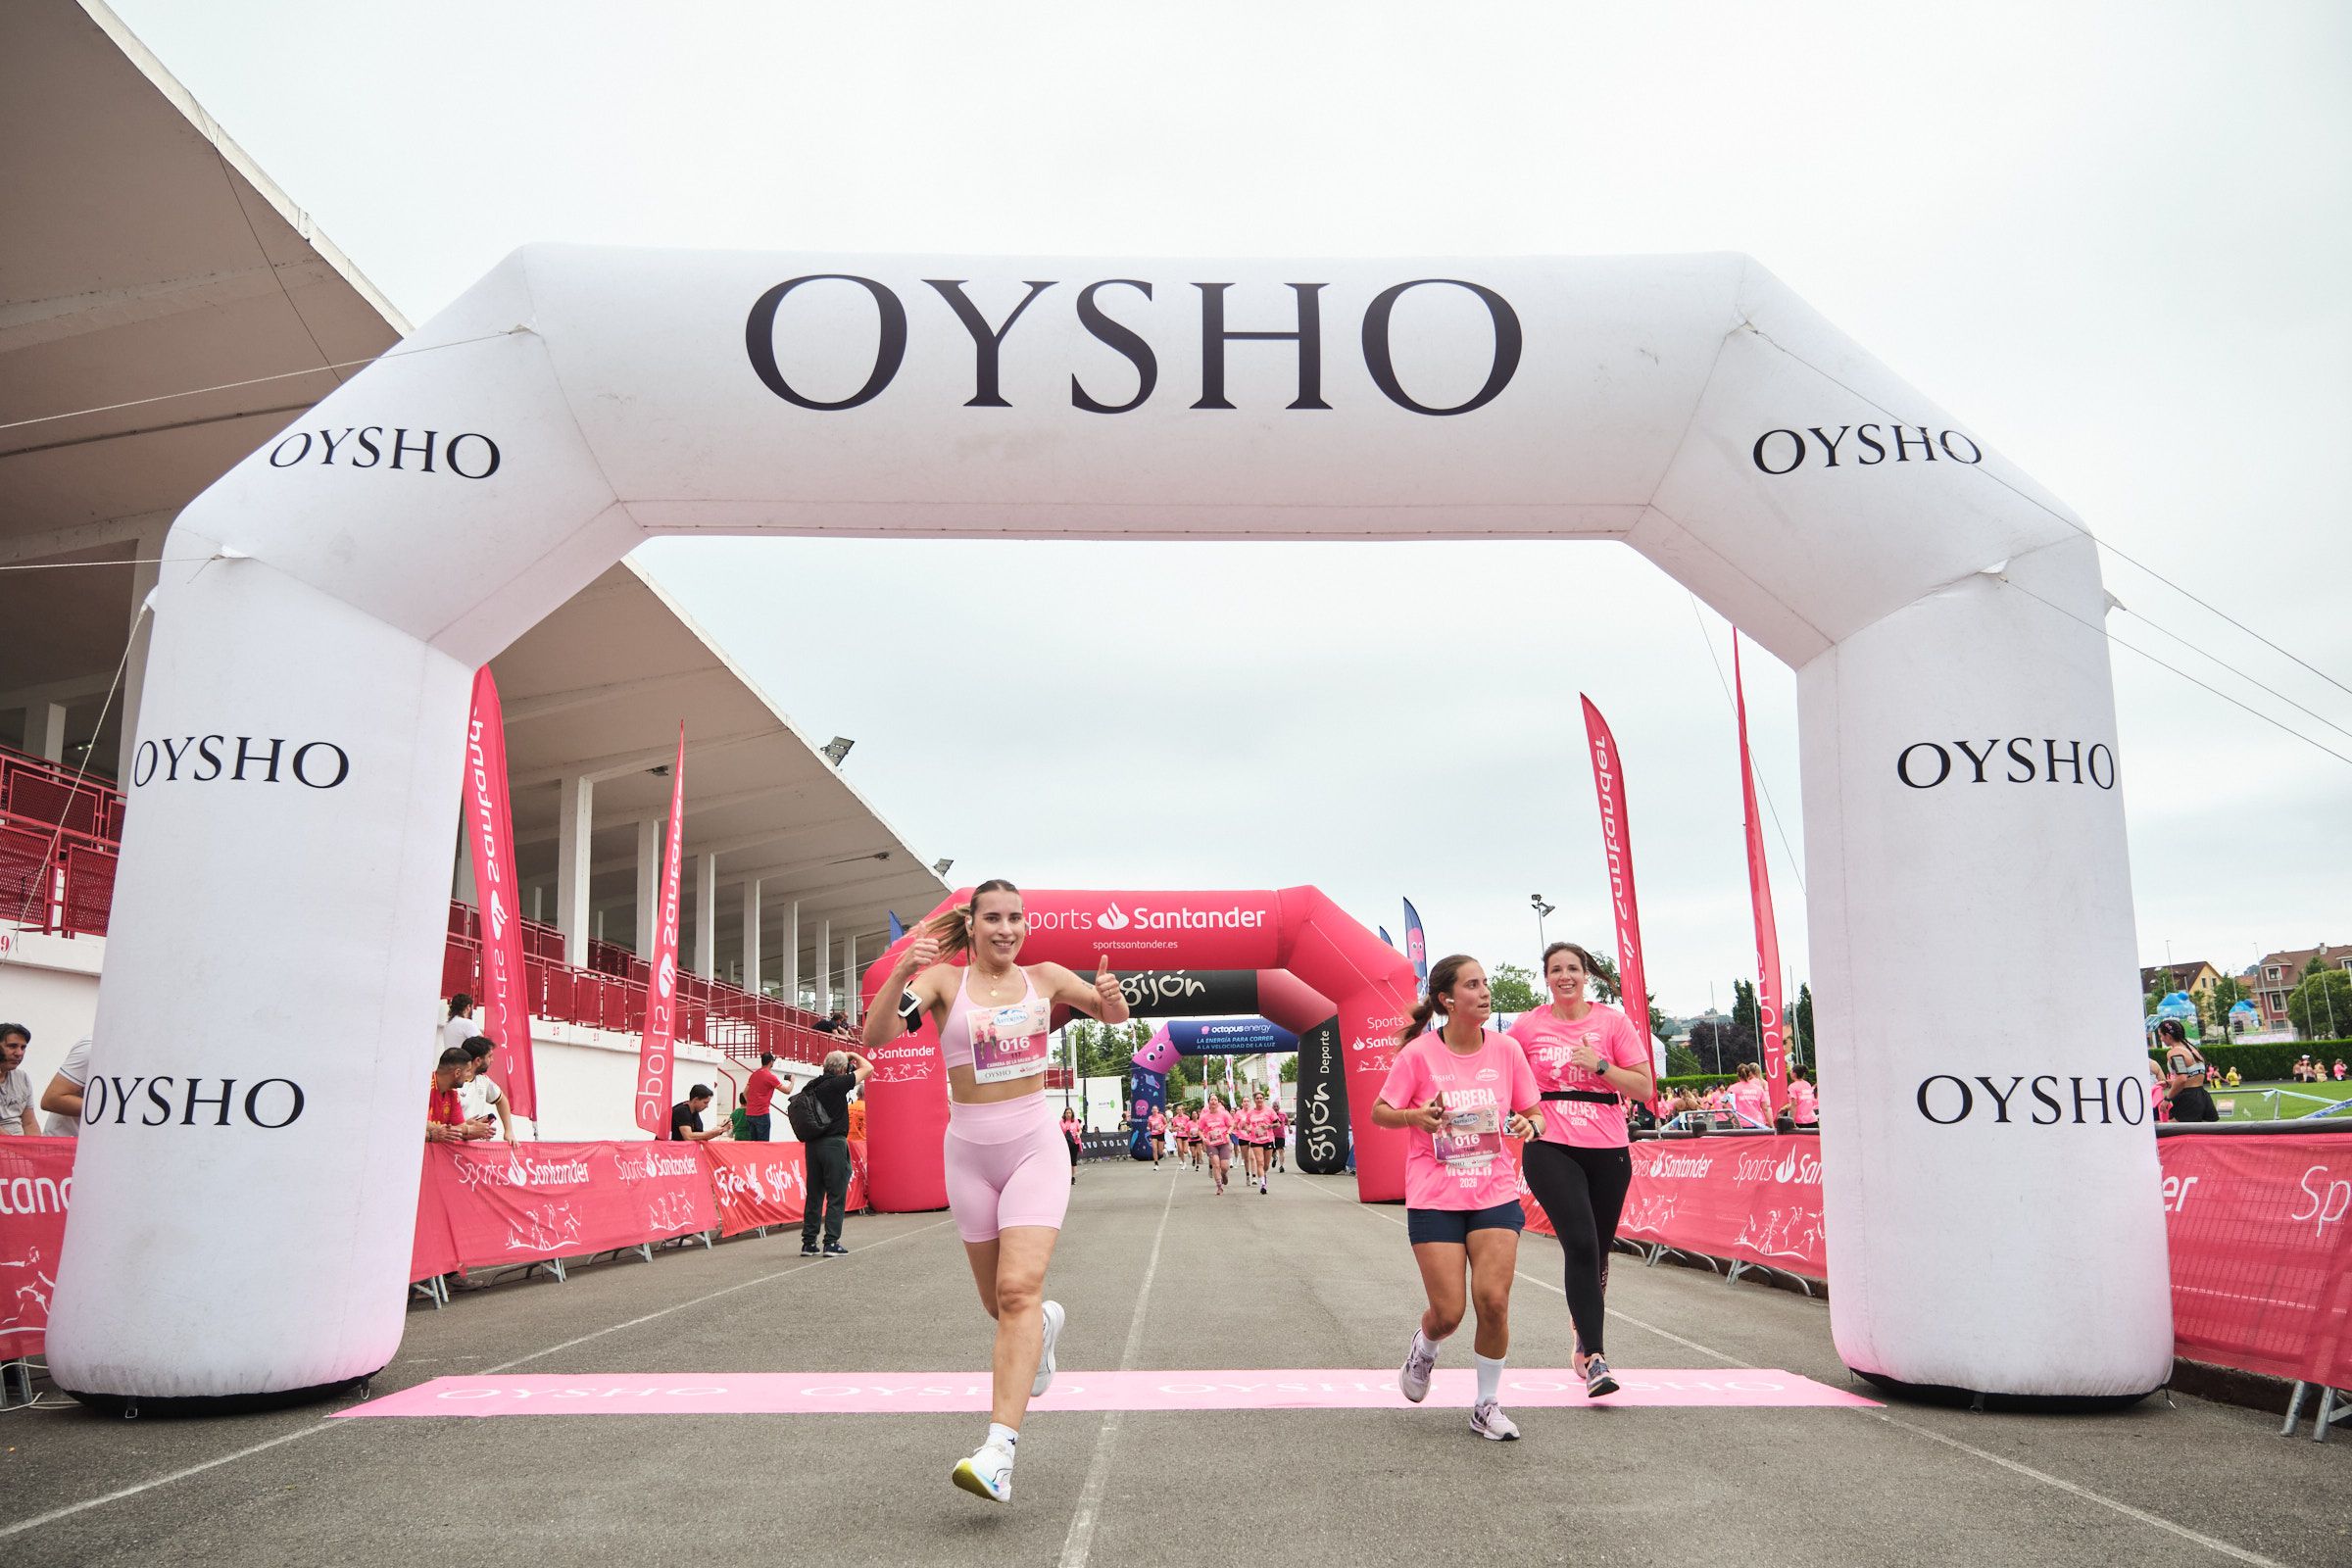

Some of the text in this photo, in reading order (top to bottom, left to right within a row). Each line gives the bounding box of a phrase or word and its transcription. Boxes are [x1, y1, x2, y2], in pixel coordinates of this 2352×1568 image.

[746, 274, 1523, 416] OYSHO
[270, 426, 501, 479] OYSHO
[1753, 423, 1983, 475] OYSHO
[134, 734, 349, 789] OYSHO
[1898, 737, 2115, 790] OYSHO
[1026, 906, 1266, 935] ports Santander
[1093, 939, 1178, 951] sportssantander.es
[1119, 969, 1205, 1006] gijón
[1211, 1024, 1271, 1034] octopus energy
[1367, 1015, 1404, 1031] Sports
[877, 1046, 935, 1059] Santander
[999, 1037, 1030, 1053] 016
[1320, 1030, 1333, 1074] Deporte
[1540, 1046, 1574, 1061] CARR
[984, 1069, 1011, 1079] OYSHO
[84, 1075, 305, 1129] OYSHO
[1442, 1088, 1497, 1108] ARRERA
[1917, 1074, 2144, 1126] OYSHO
[1304, 1082, 1337, 1161] gijón
[1454, 1134, 1480, 1147] 016
[454, 1153, 589, 1192] Sports Santander
[614, 1153, 697, 1185] Sports Santander
[1659, 1152, 1713, 1178] Santander
[1733, 1152, 1777, 1188] Sports
[2291, 1165, 2351, 1237] Sp
[437, 1387, 729, 1399] OYSHO
